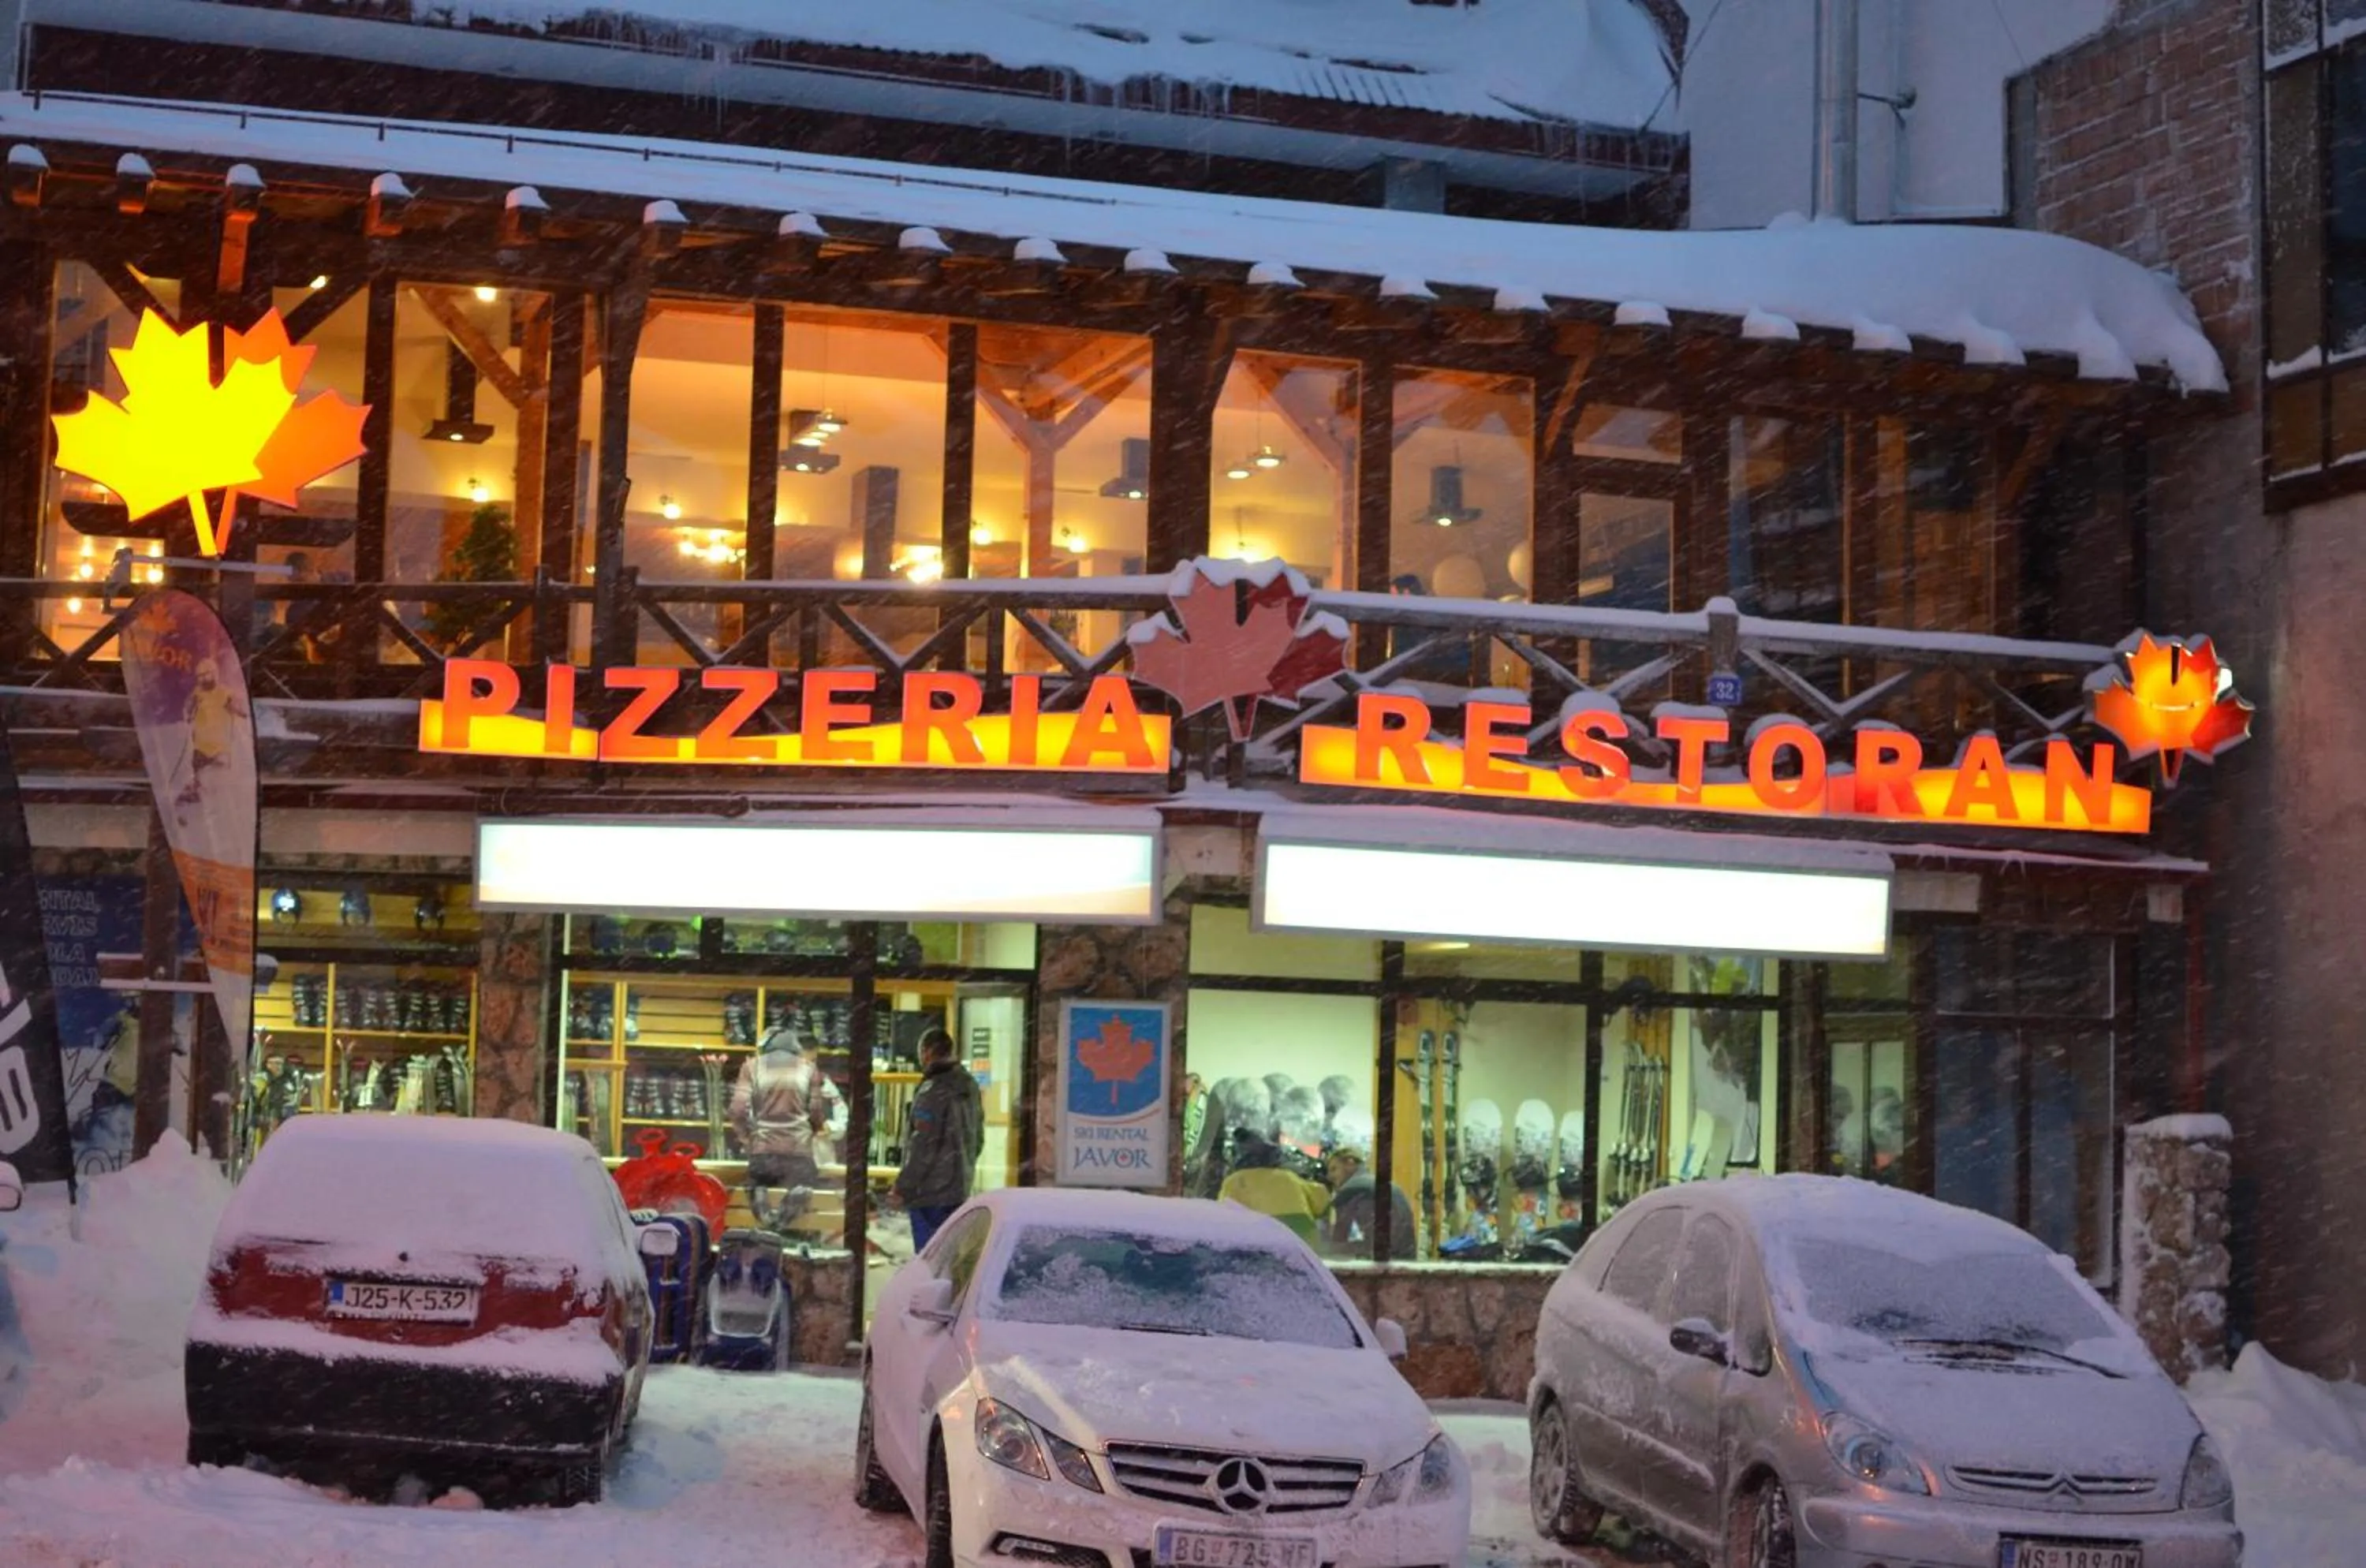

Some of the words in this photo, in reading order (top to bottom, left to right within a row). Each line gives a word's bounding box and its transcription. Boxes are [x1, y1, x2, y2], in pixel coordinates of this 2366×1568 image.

[1716, 681, 1734, 700] 32
[442, 658, 1157, 768] PIZZERIA
[1354, 692, 2115, 825] RESTORAN
[1097, 1126, 1149, 1141] RENTAL
[1073, 1146, 1153, 1169] JAVOR
